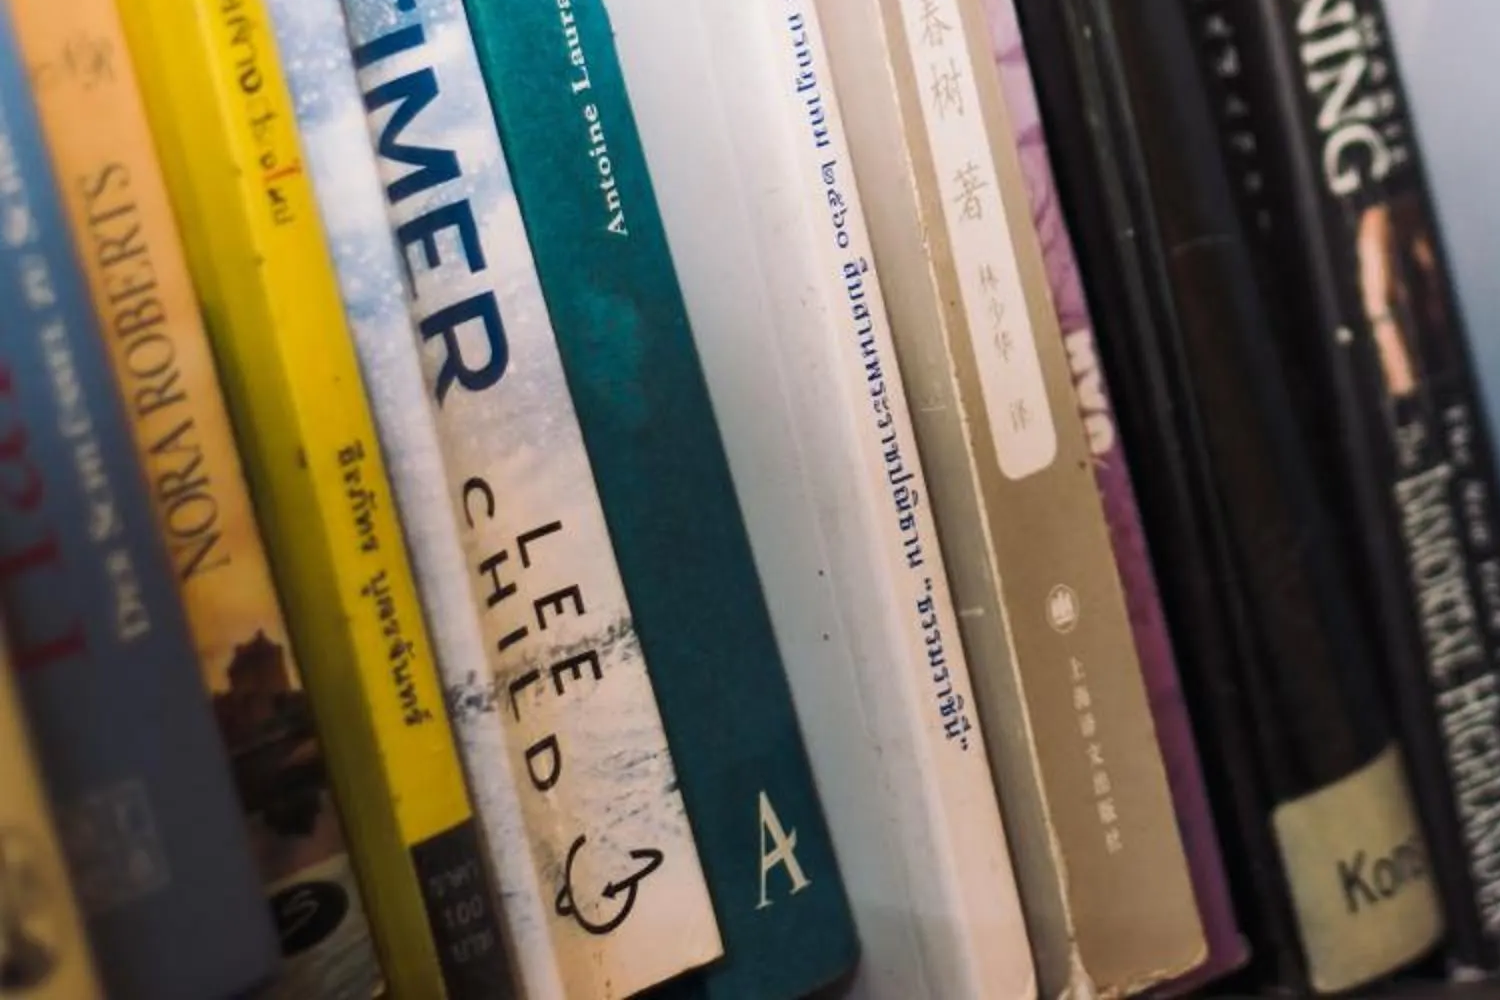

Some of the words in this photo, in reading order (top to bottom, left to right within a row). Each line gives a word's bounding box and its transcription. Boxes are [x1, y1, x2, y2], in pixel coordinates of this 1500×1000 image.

[786, 13, 831, 149] กรกฎาคม
[582, 103, 629, 237] Antoine
[80, 162, 181, 418] ROBERTS
[147, 418, 232, 582] NORA
[461, 475, 563, 793] CHILD
[517, 519, 603, 698] LEE
[755, 790, 811, 910] A
